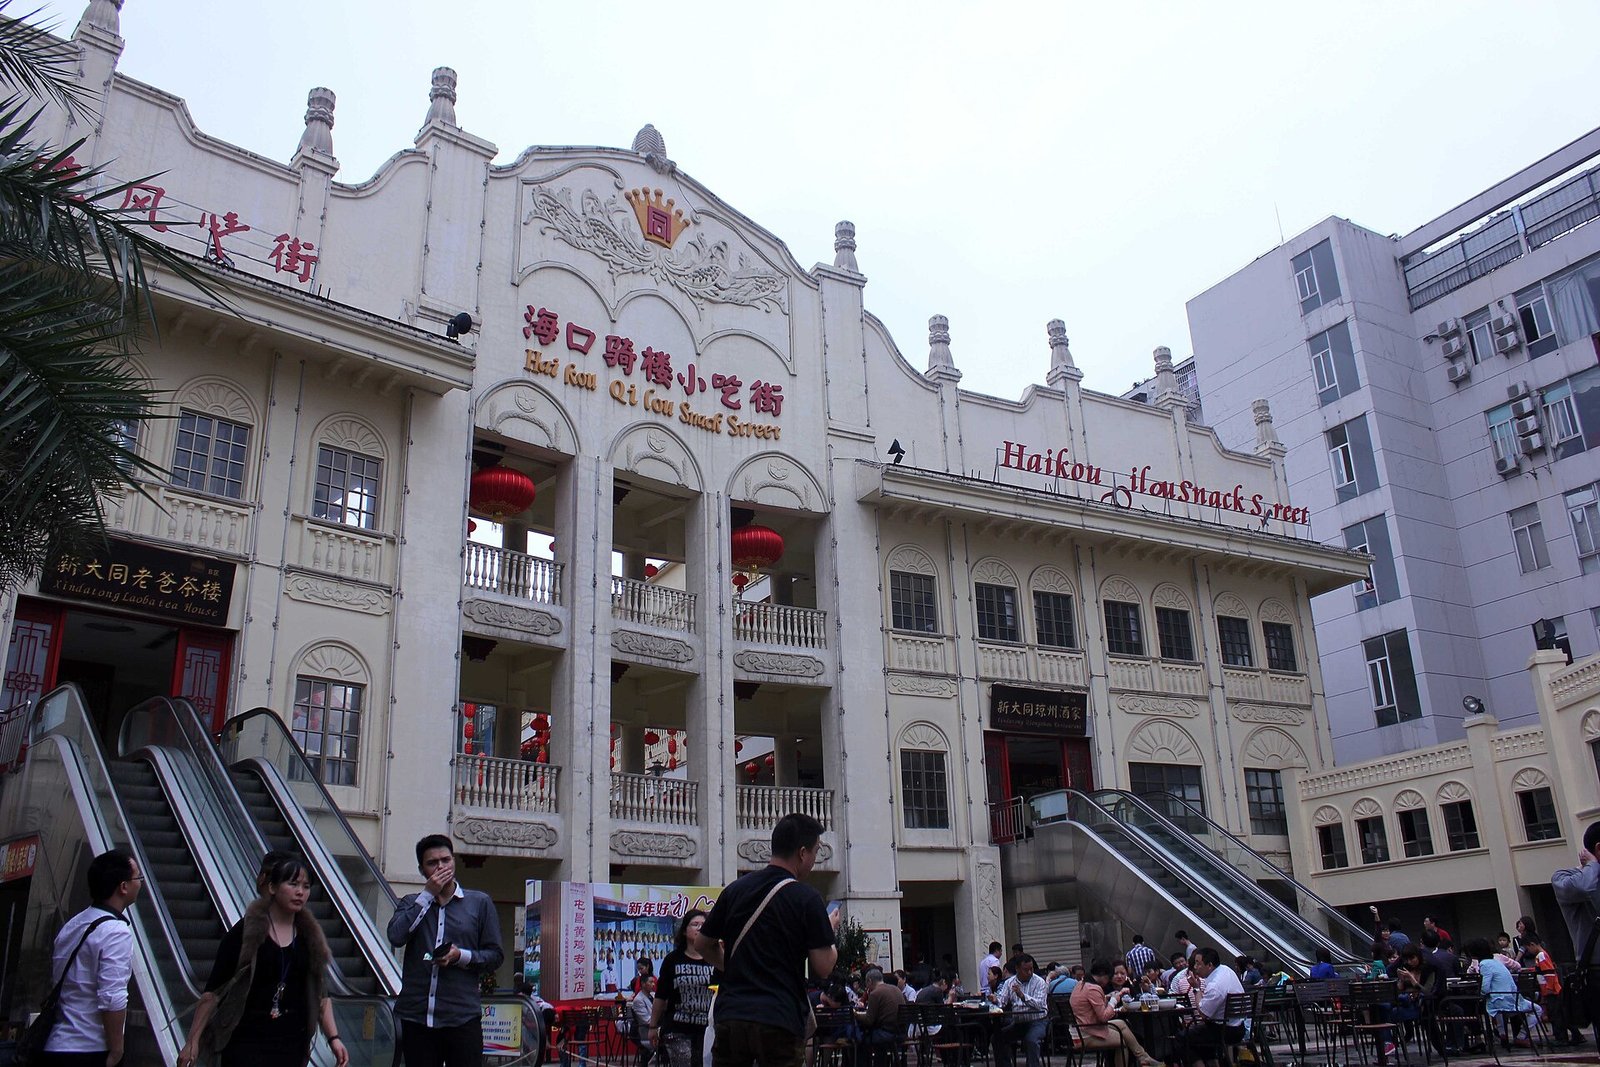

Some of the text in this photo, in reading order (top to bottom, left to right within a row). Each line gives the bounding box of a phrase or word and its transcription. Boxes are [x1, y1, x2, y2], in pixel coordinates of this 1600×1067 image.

[523, 305, 785, 417] 海口骑楼小吃街
[523, 348, 559, 378] Hai
[609, 379, 638, 406] Qi
[679, 402, 723, 433] Snack
[727, 415, 782, 441] Street
[1000, 440, 1101, 486] Haikou
[56, 553, 222, 603] 新大同老爸茶楼
[183, 601, 219, 618] House
[573, 899, 586, 993] 屯昌黄鸡专卖店
[675, 963, 715, 976] DESTROY
